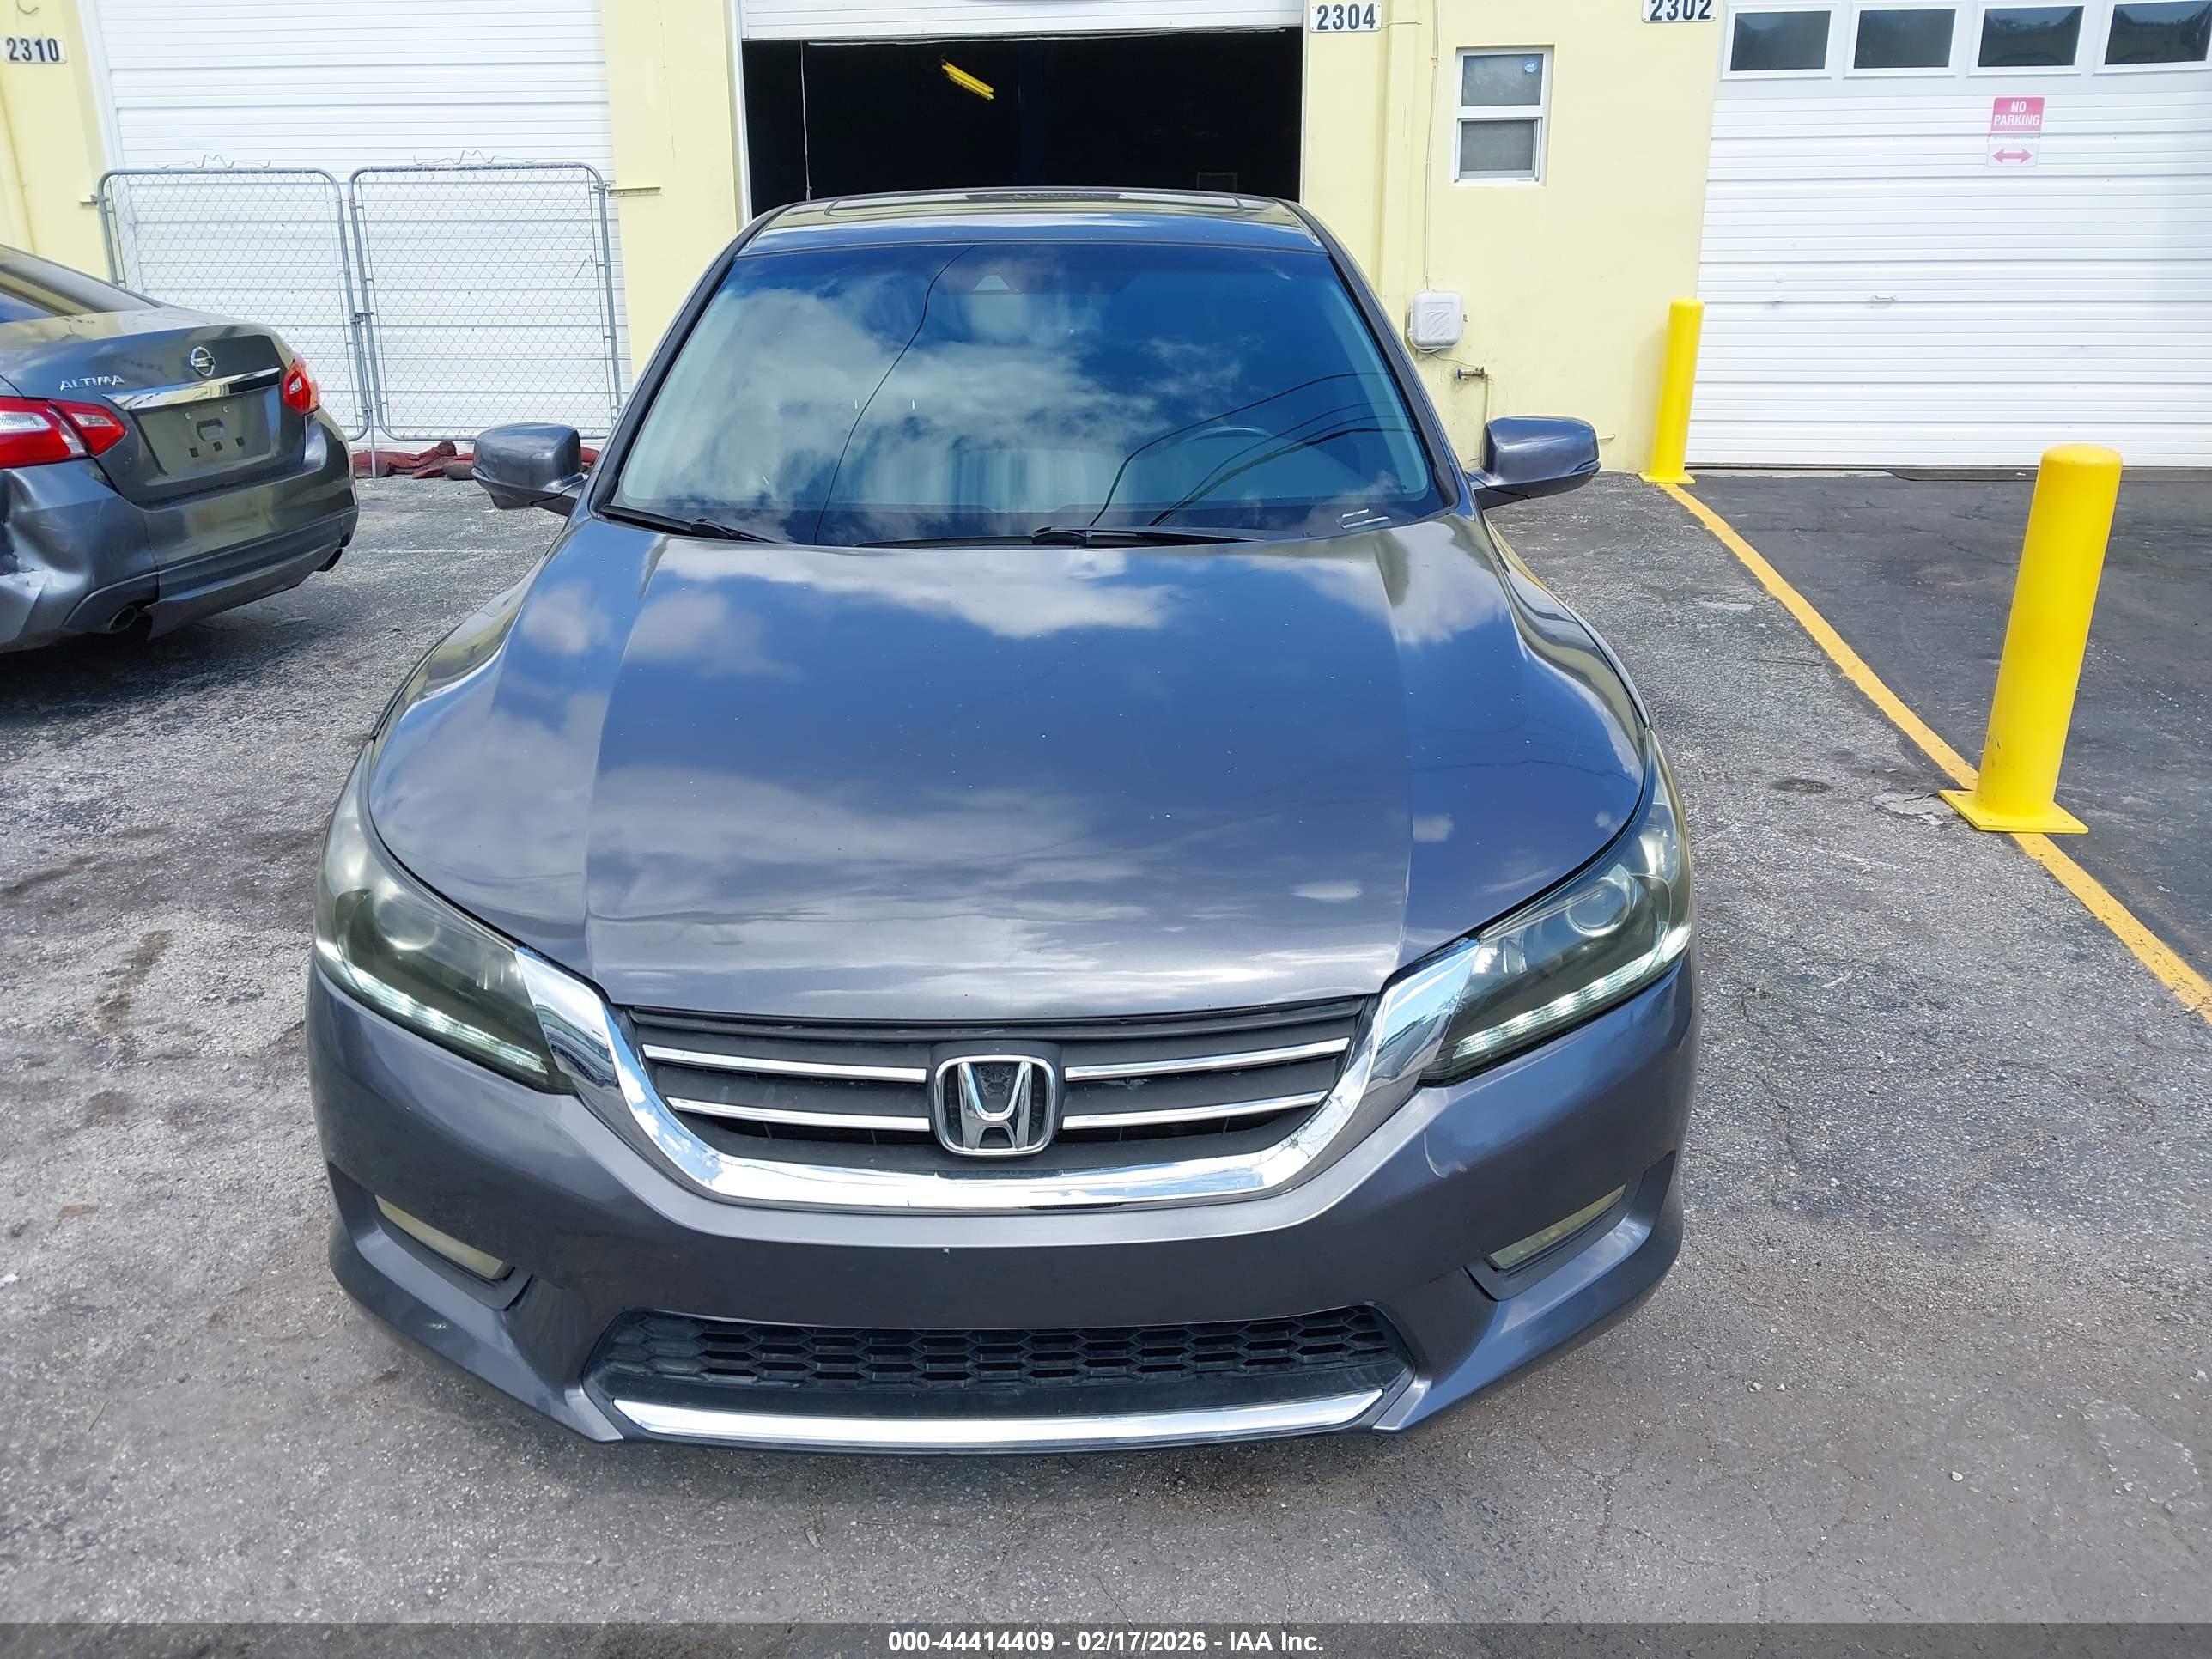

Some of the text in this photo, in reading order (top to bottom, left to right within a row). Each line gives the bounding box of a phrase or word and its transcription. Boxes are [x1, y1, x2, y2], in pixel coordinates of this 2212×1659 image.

[1317, 3, 1376, 30] 2304
[1650, 0, 1712, 21] 2302
[7, 37, 59, 62] 2310
[2011, 101, 2027, 112] NO
[1994, 114, 2040, 125] PARKING
[60, 375, 125, 391] ALTIMA
